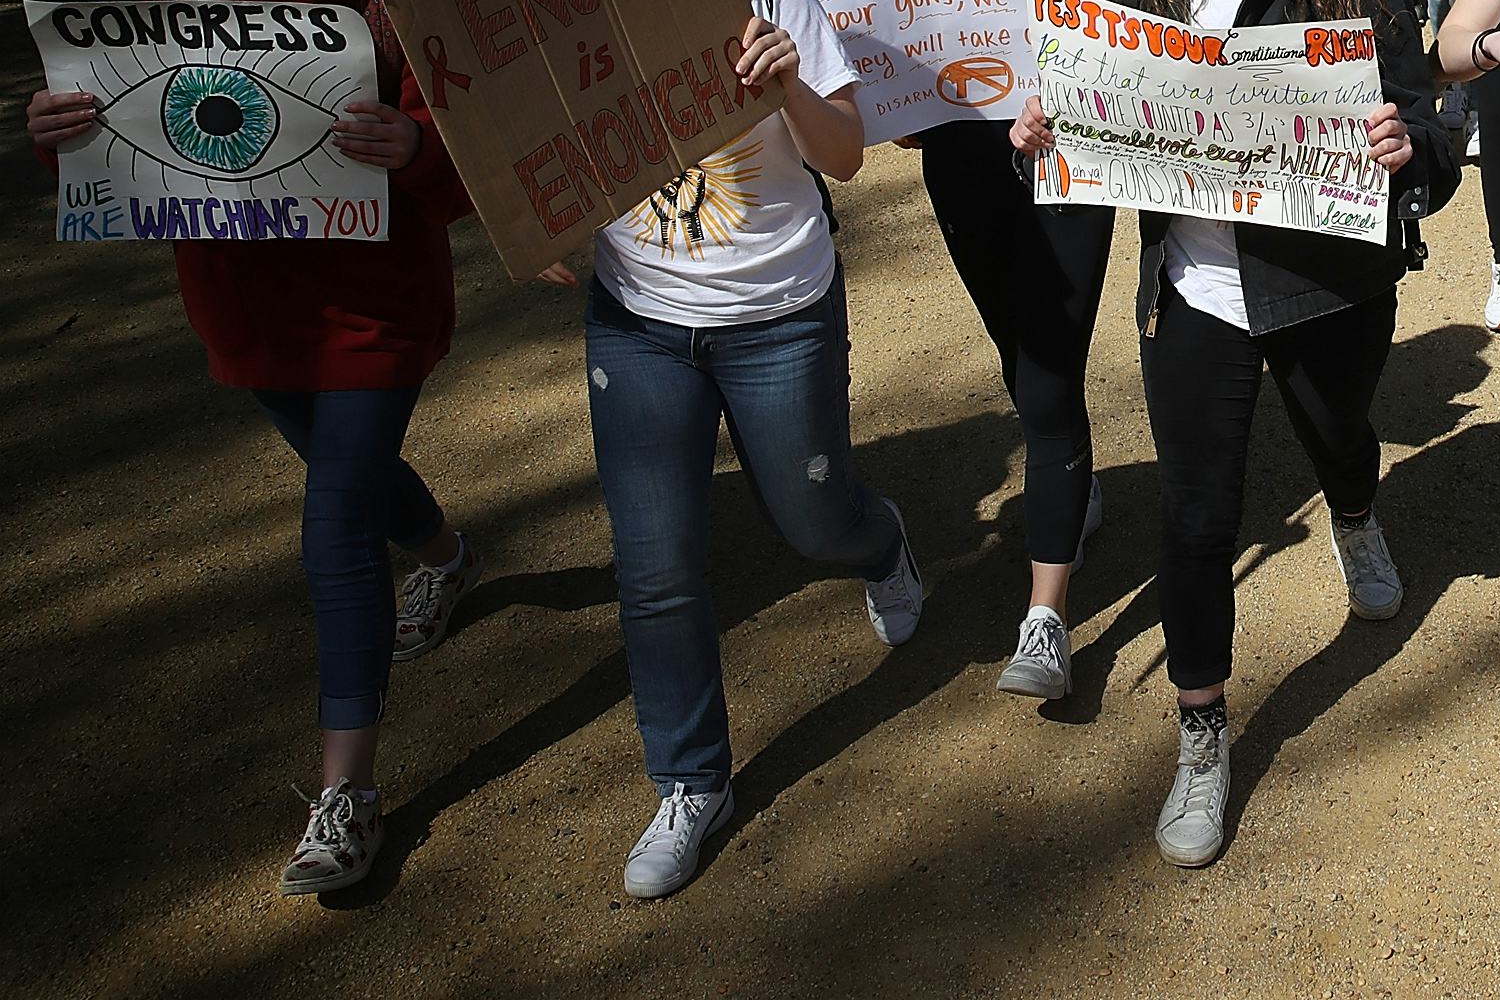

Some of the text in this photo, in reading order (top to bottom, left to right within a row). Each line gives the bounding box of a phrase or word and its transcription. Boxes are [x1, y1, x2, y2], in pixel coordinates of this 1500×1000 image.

[52, 3, 347, 52] CONGRESS
[905, 33, 944, 58] will
[958, 29, 1011, 48] take
[1081, 1, 1142, 50] IT'S
[1142, 20, 1228, 66] YOUR
[1304, 28, 1375, 67] RIGHT
[577, 41, 615, 91] is
[1093, 52, 1150, 96] that
[1157, 80, 1215, 106] was
[1226, 83, 1327, 106] written
[877, 88, 936, 117] DISARM
[1038, 73, 1080, 118] LACK
[1077, 87, 1131, 127] PEOPLE
[1131, 97, 1205, 136] COUNTED
[1213, 111, 1234, 143] AS
[1294, 115, 1312, 144] OF
[513, 50, 734, 239] ENOUGH
[1280, 143, 1345, 181] WHITE
[1342, 150, 1385, 191] MEN
[66, 179, 115, 208] WE
[1109, 159, 1164, 205] GUNS
[1229, 180, 1282, 192] CAPABLE
[1233, 190, 1262, 215] OF
[1319, 184, 1361, 204] DOZENS
[1364, 195, 1378, 207] IN
[62, 196, 381, 240] ARE WATCHING YOU
